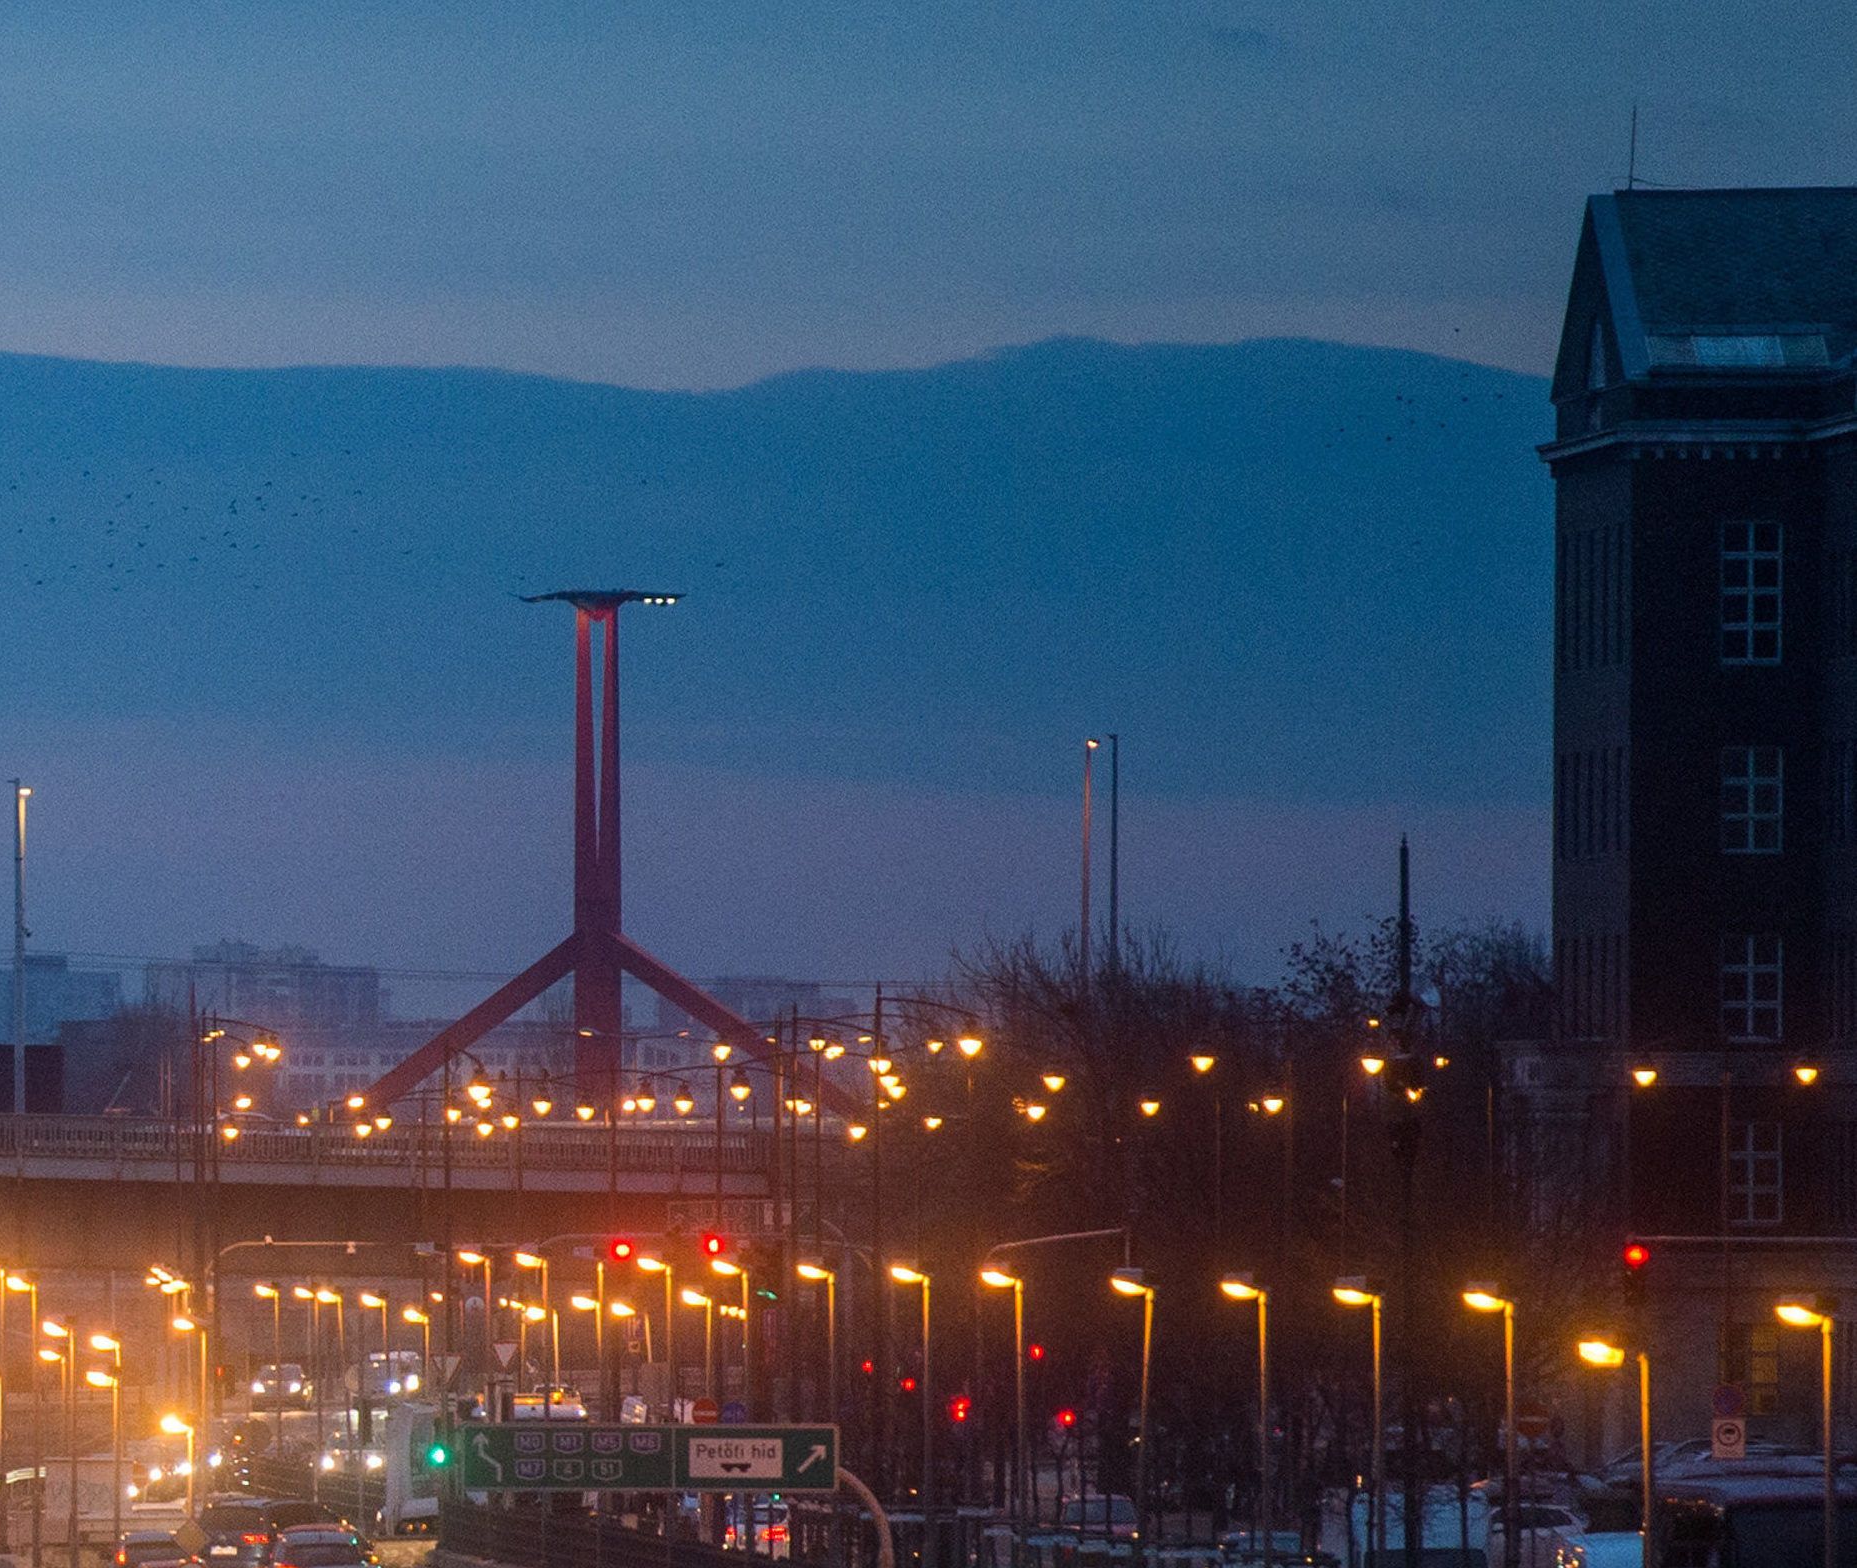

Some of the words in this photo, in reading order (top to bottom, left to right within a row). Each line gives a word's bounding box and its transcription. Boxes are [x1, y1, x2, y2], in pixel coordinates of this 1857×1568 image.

[597, 1436, 617, 1449] M5
[696, 1443, 745, 1459] Petőfi
[751, 1443, 776, 1459] híd
[520, 1462, 540, 1474] M7
